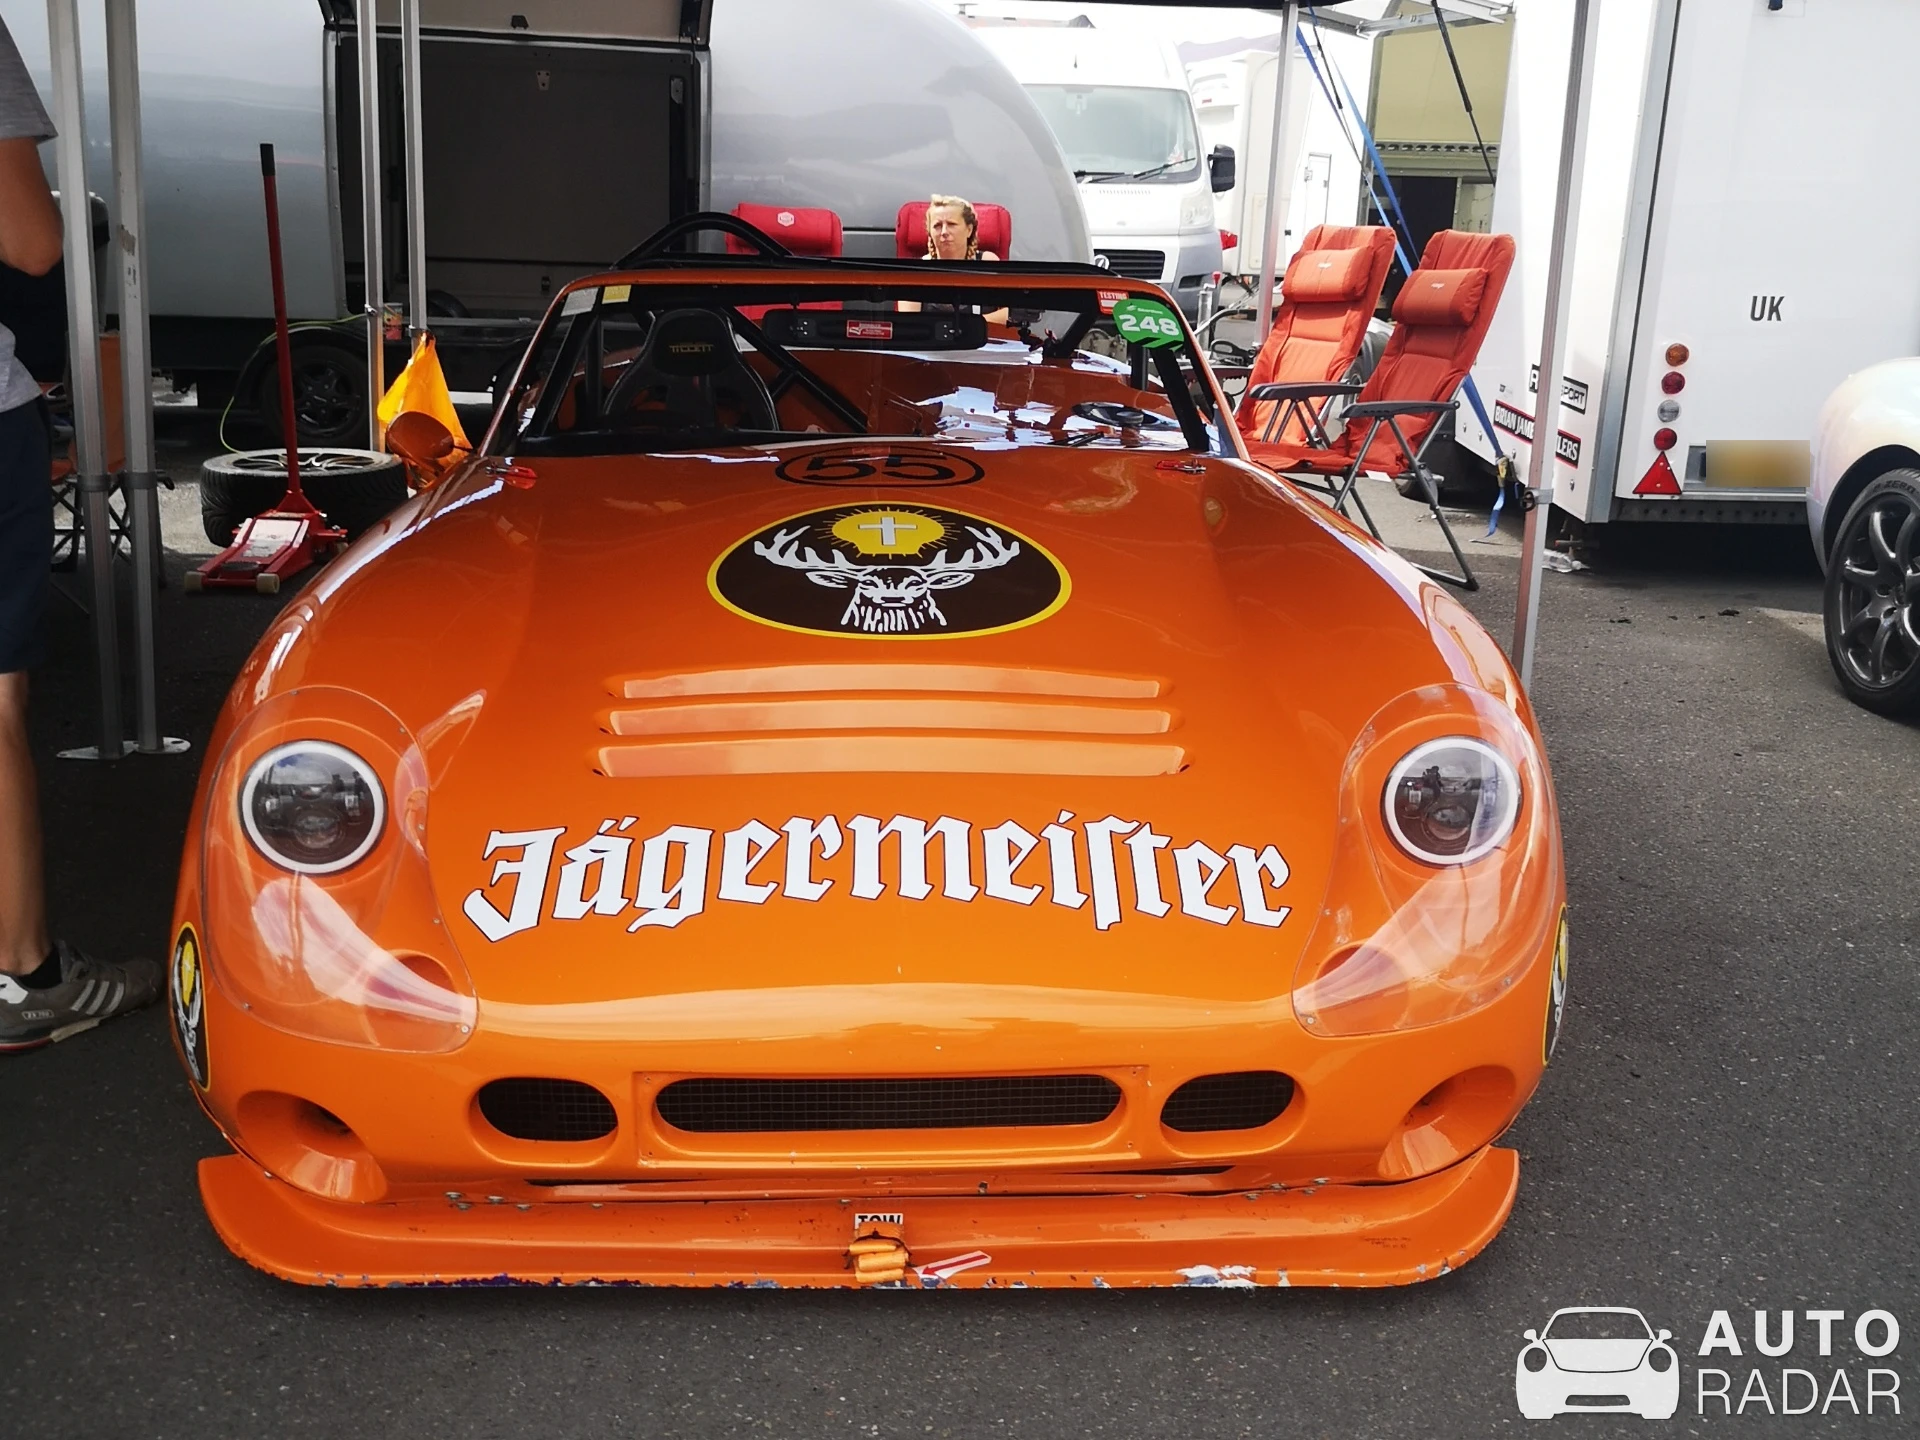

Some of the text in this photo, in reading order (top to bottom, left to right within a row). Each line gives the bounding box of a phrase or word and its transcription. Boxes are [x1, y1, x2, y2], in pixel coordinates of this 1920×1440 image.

[1750, 295, 1785, 322] UK
[1118, 313, 1180, 336] 248
[1495, 406, 1535, 440] BRIAN JAME
[802, 453, 956, 481] 55
